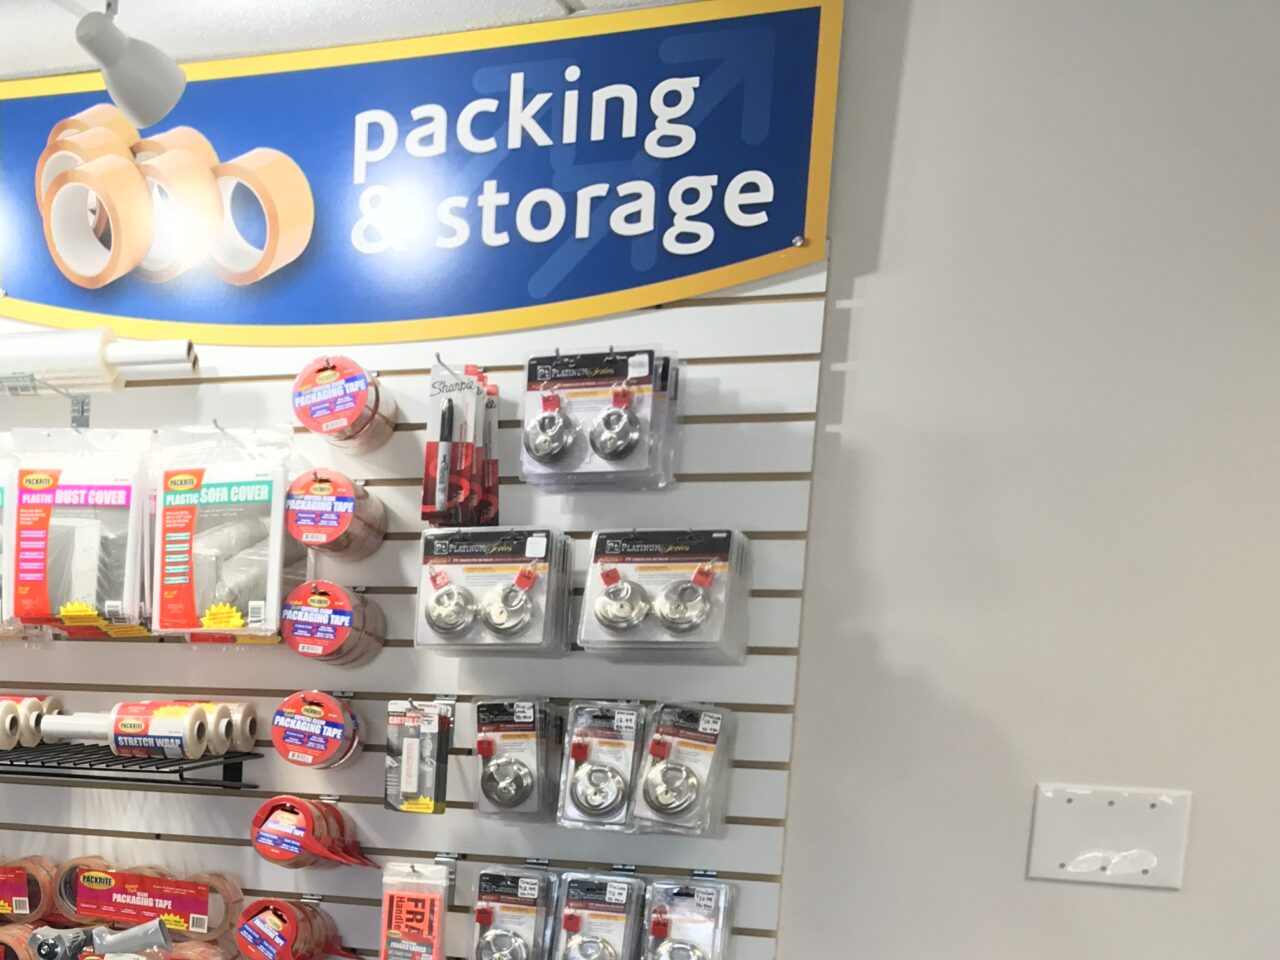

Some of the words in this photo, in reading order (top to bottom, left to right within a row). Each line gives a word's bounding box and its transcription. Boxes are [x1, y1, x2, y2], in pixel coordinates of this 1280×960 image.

[351, 65, 703, 183] packing
[351, 188, 412, 253] &
[435, 171, 775, 256] storage
[22, 494, 53, 504] PLASTIC
[55, 490, 85, 504] DUST
[88, 490, 126, 505] COVER
[166, 494, 199, 506] PLASTIC
[200, 487, 228, 503] SOFA
[231, 485, 268, 501] COVER
[282, 609, 328, 625] PACKAGING
[330, 613, 350, 627] TAPE
[274, 715, 321, 734] PACKAGING
[322, 726, 342, 739] TAPE
[118, 735, 153, 748] STRETCH
[155, 736, 182, 749] WRAP
[82, 875, 113, 887] PACKRITE
[112, 893, 153, 907] PACKAGING
[154, 899, 171, 909] TAPE
[394, 896, 405, 930] Handle
